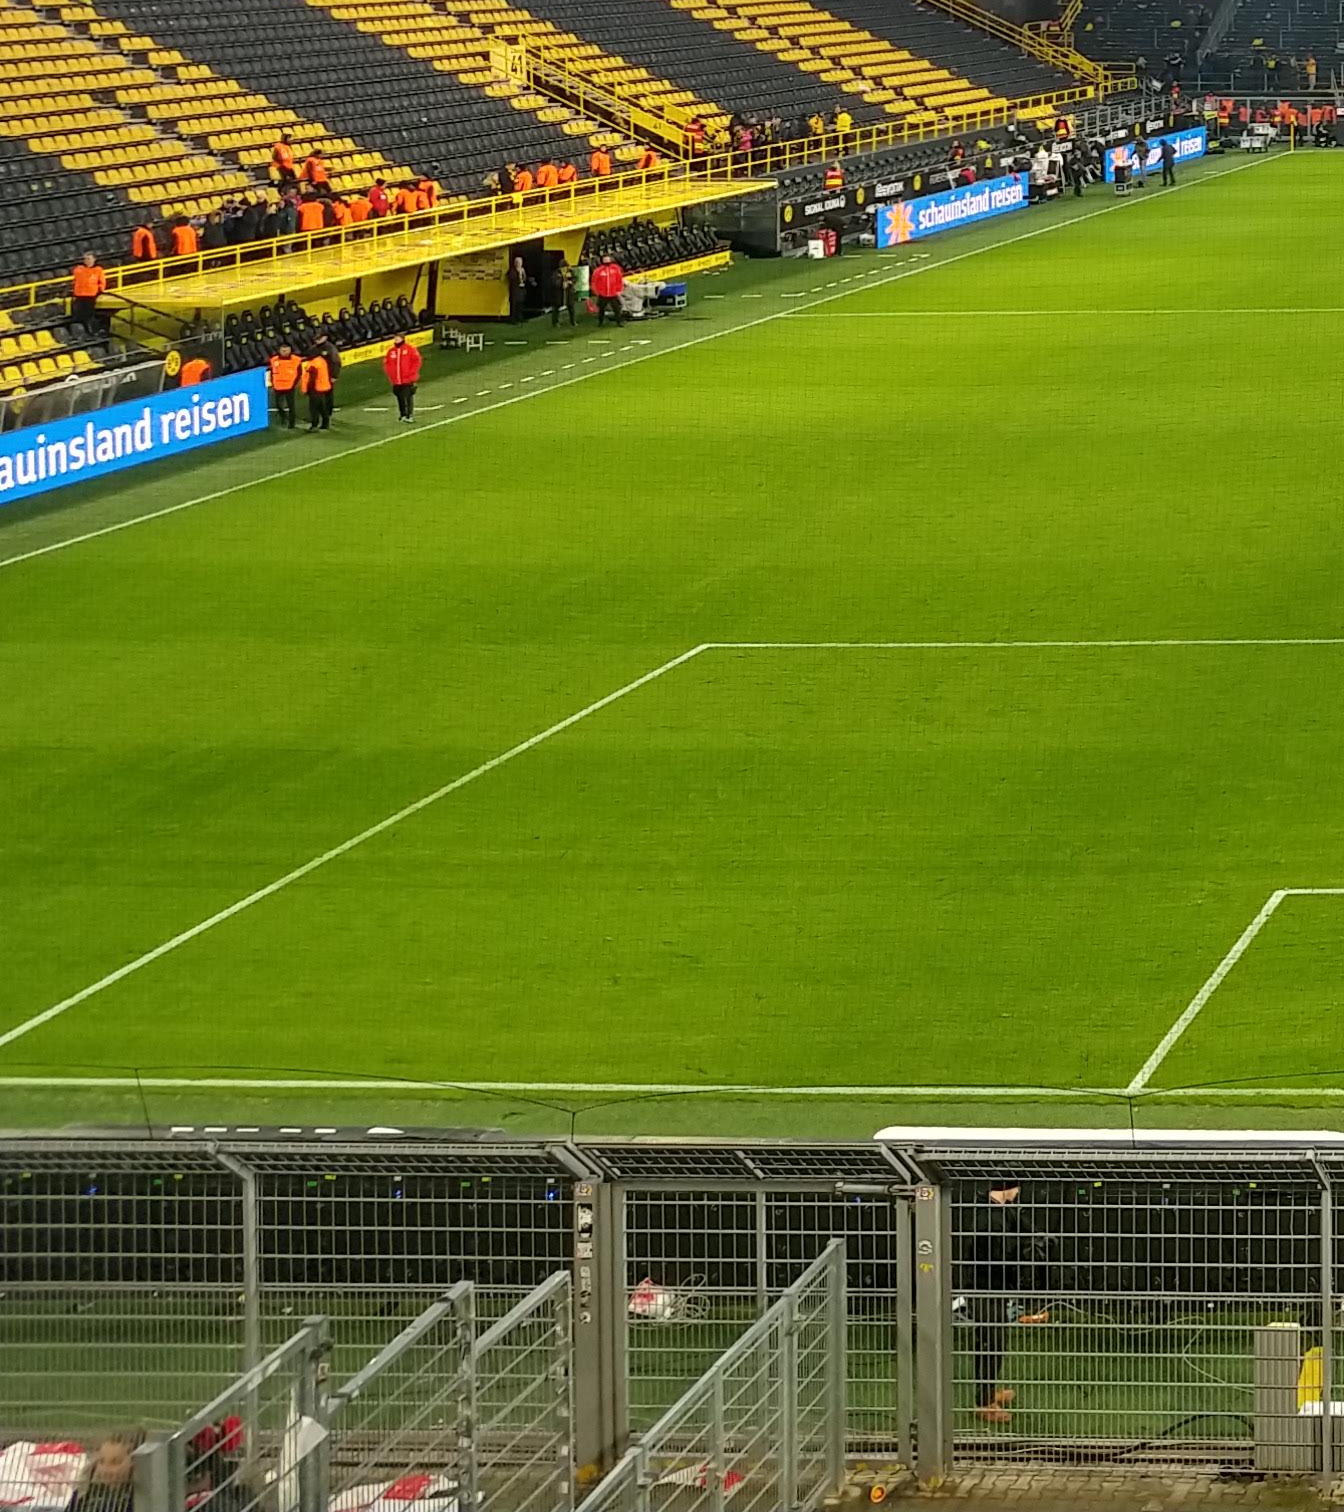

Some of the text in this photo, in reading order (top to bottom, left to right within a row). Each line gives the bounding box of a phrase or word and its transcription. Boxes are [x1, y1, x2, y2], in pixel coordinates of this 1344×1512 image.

[511, 54, 523, 76] 41
[918, 183, 1023, 230] schauinsland reisen
[0, 392, 250, 489] auinsland reisen
